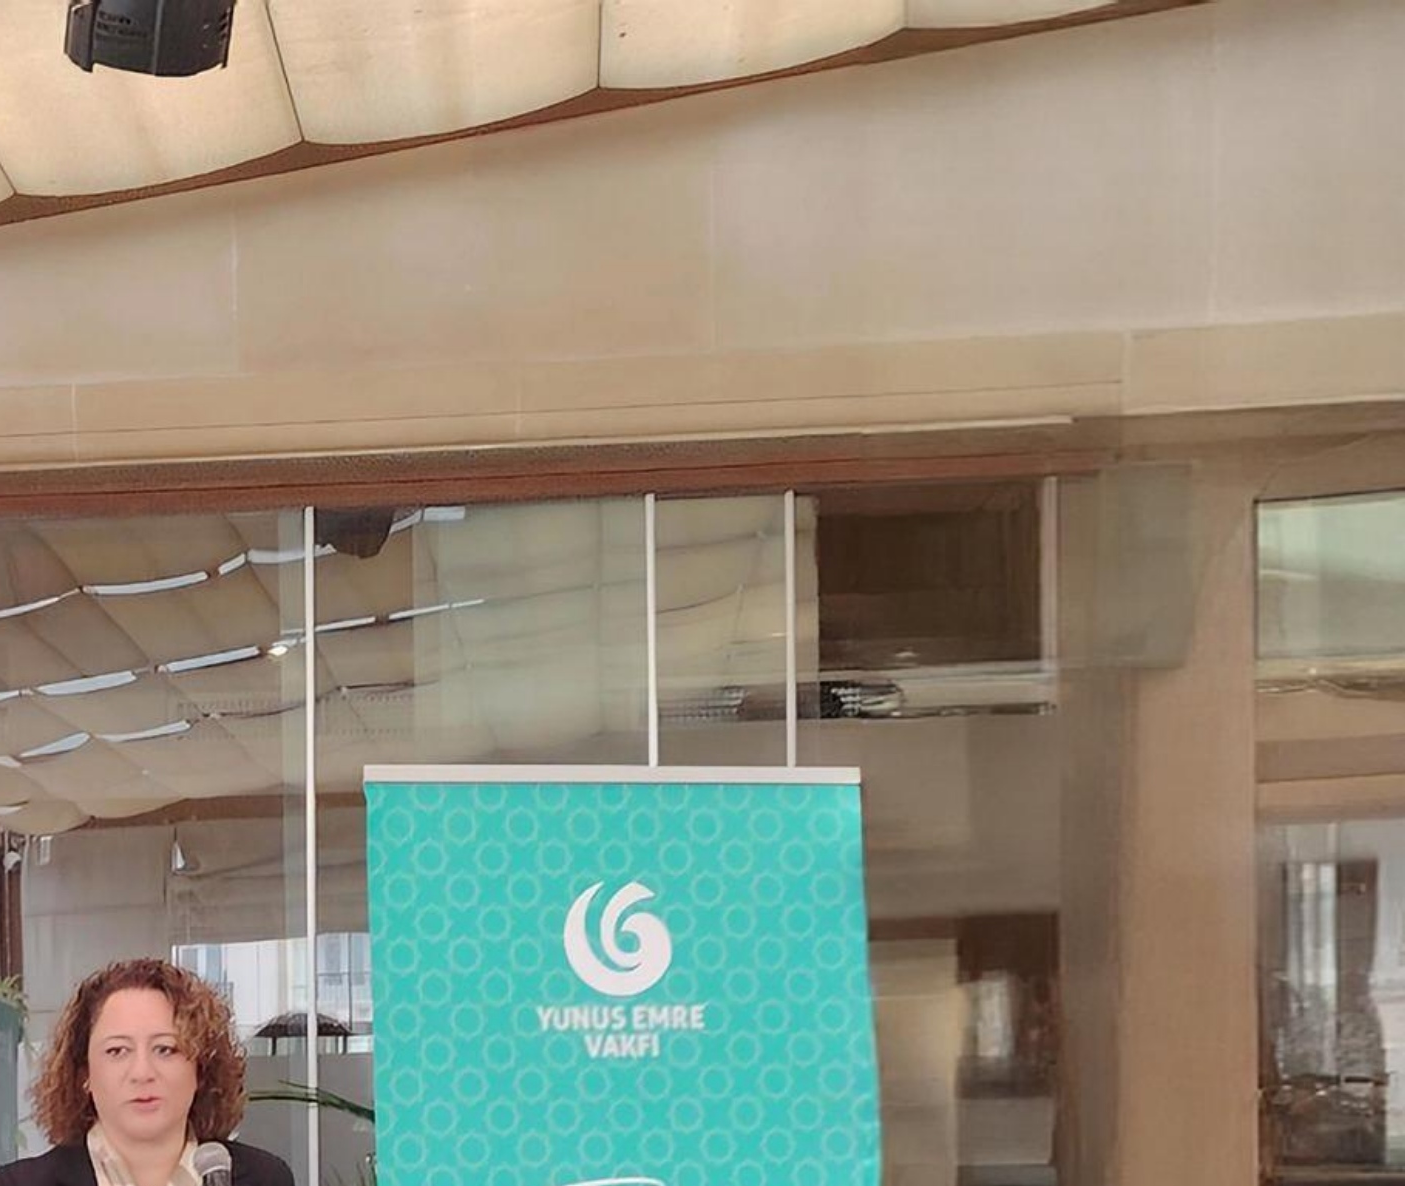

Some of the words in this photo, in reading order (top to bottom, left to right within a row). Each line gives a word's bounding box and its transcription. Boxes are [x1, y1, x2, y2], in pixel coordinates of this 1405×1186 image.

[536, 1004, 627, 1031] YUNUS
[632, 1004, 705, 1031] EMRE
[584, 1033, 661, 1059] VAKFI
